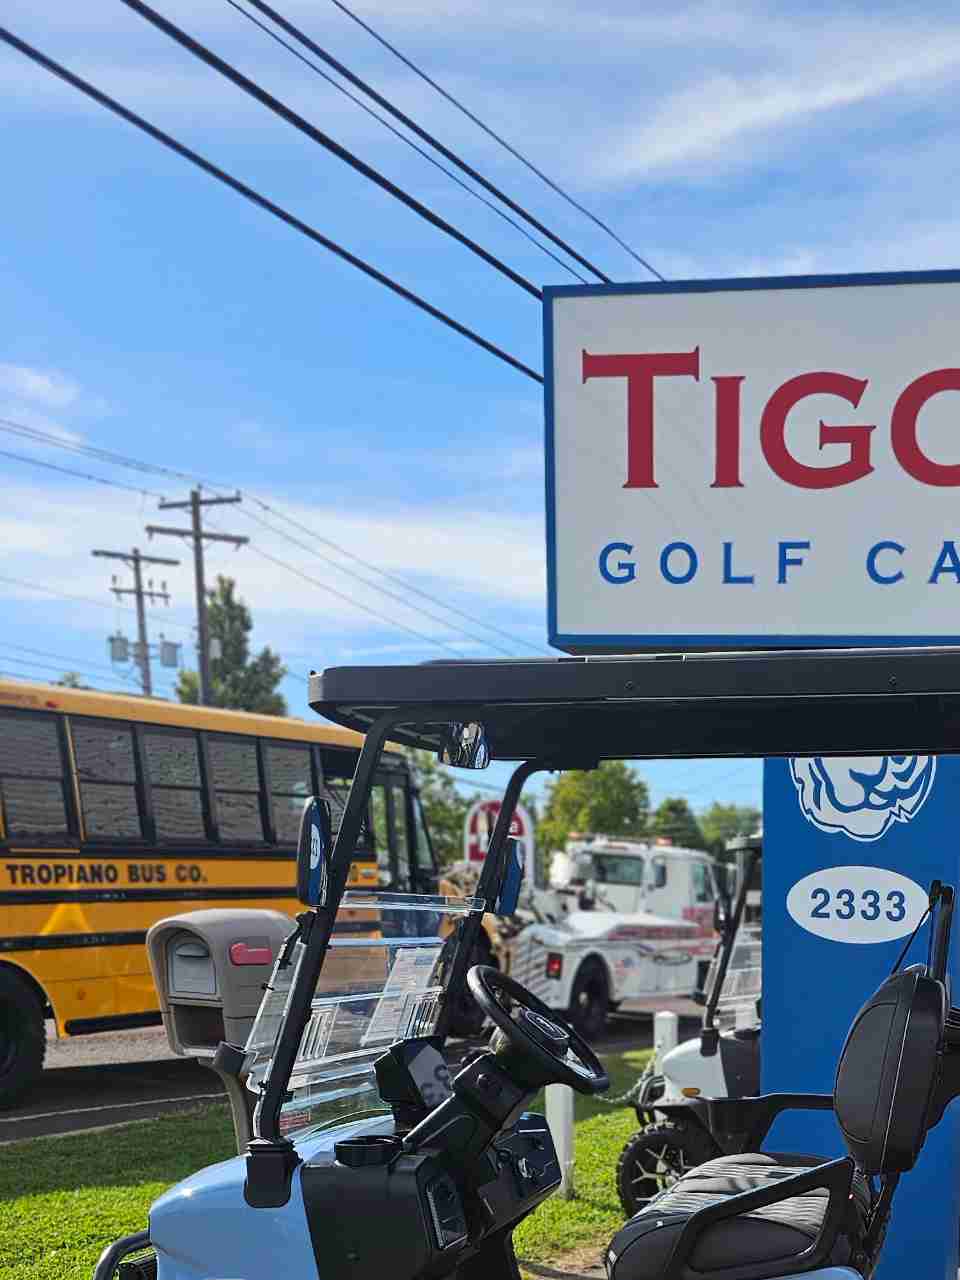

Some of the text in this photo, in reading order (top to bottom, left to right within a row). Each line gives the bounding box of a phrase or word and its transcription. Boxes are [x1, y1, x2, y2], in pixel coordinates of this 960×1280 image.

[598, 540, 812, 586] GOLF
[6, 863, 208, 884] TROPIANO BUS CO.
[810, 887, 906, 922] 2333
